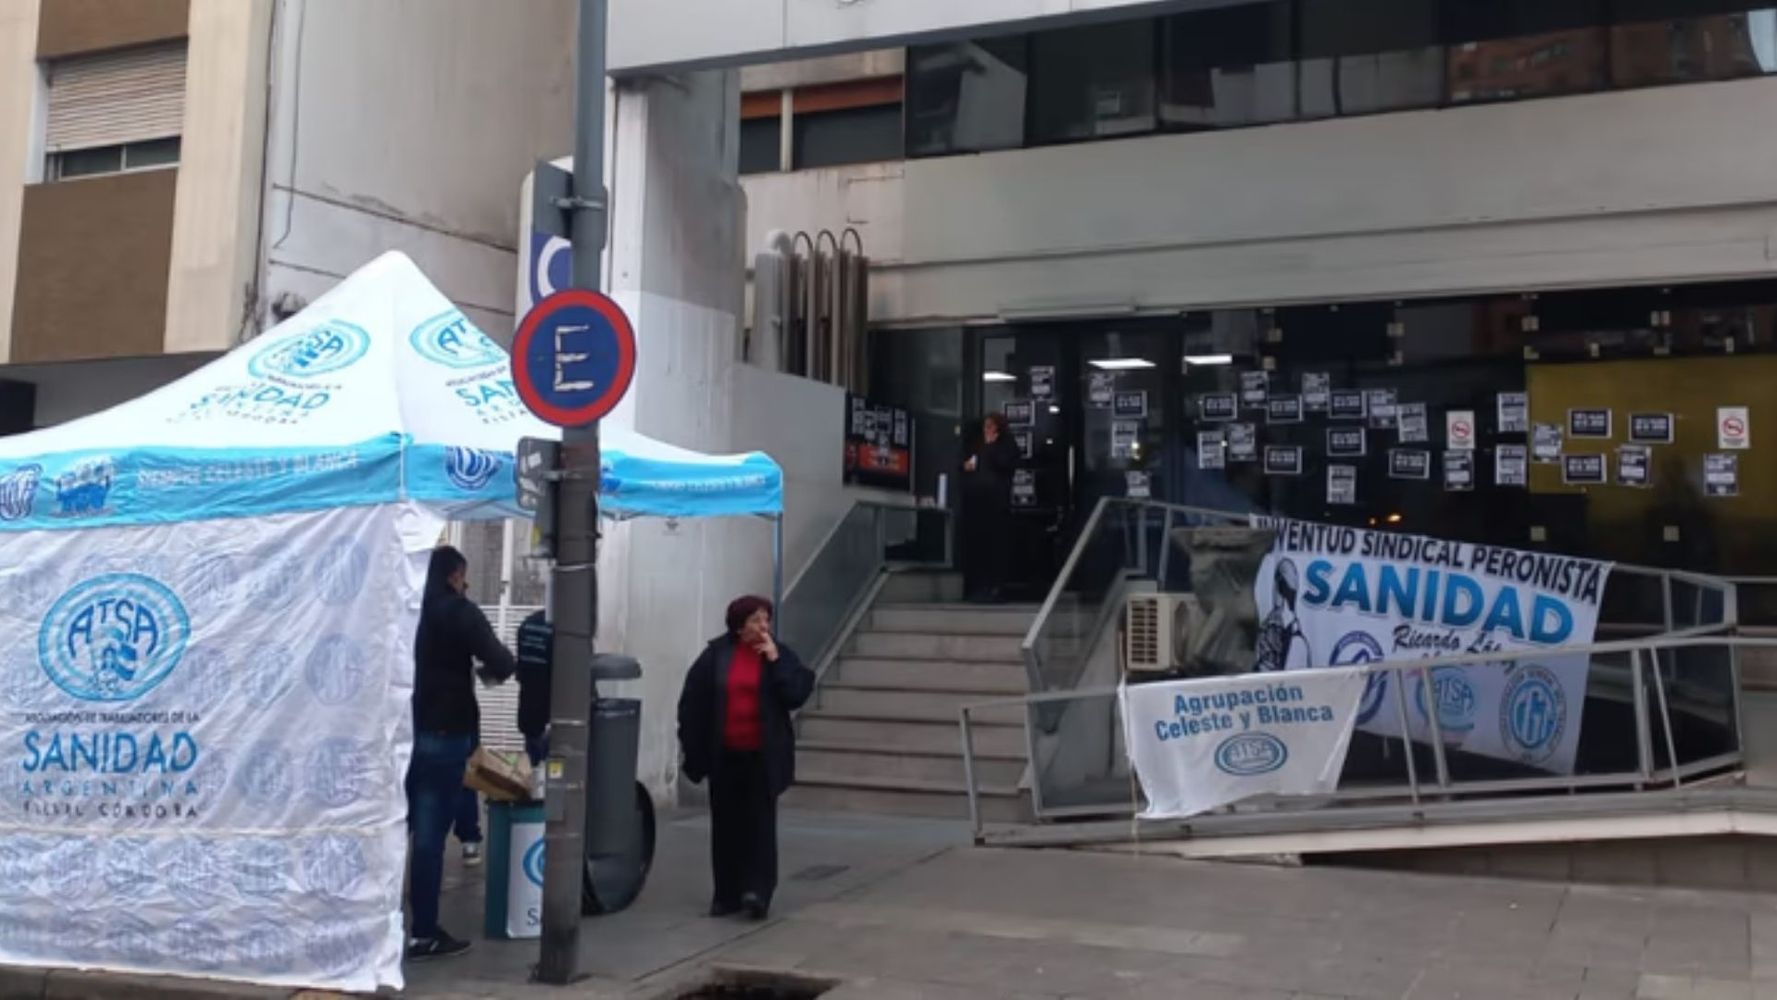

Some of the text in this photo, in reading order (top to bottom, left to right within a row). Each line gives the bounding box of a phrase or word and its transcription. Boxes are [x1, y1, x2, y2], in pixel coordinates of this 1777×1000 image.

[554, 324, 594, 391] E
[1361, 531, 1465, 568] SINDICAL
[1471, 546, 1600, 604] PERONISTA
[1302, 559, 1573, 644] SANIDAD
[67, 598, 159, 659] ATSA
[1391, 624, 1461, 652] Ricardo
[1174, 681, 1303, 715] Agrupación
[1155, 704, 1334, 741] Celeste y Blanca
[22, 730, 198, 773] SANIDAD
[22, 780, 198, 797] ARGENTINA
